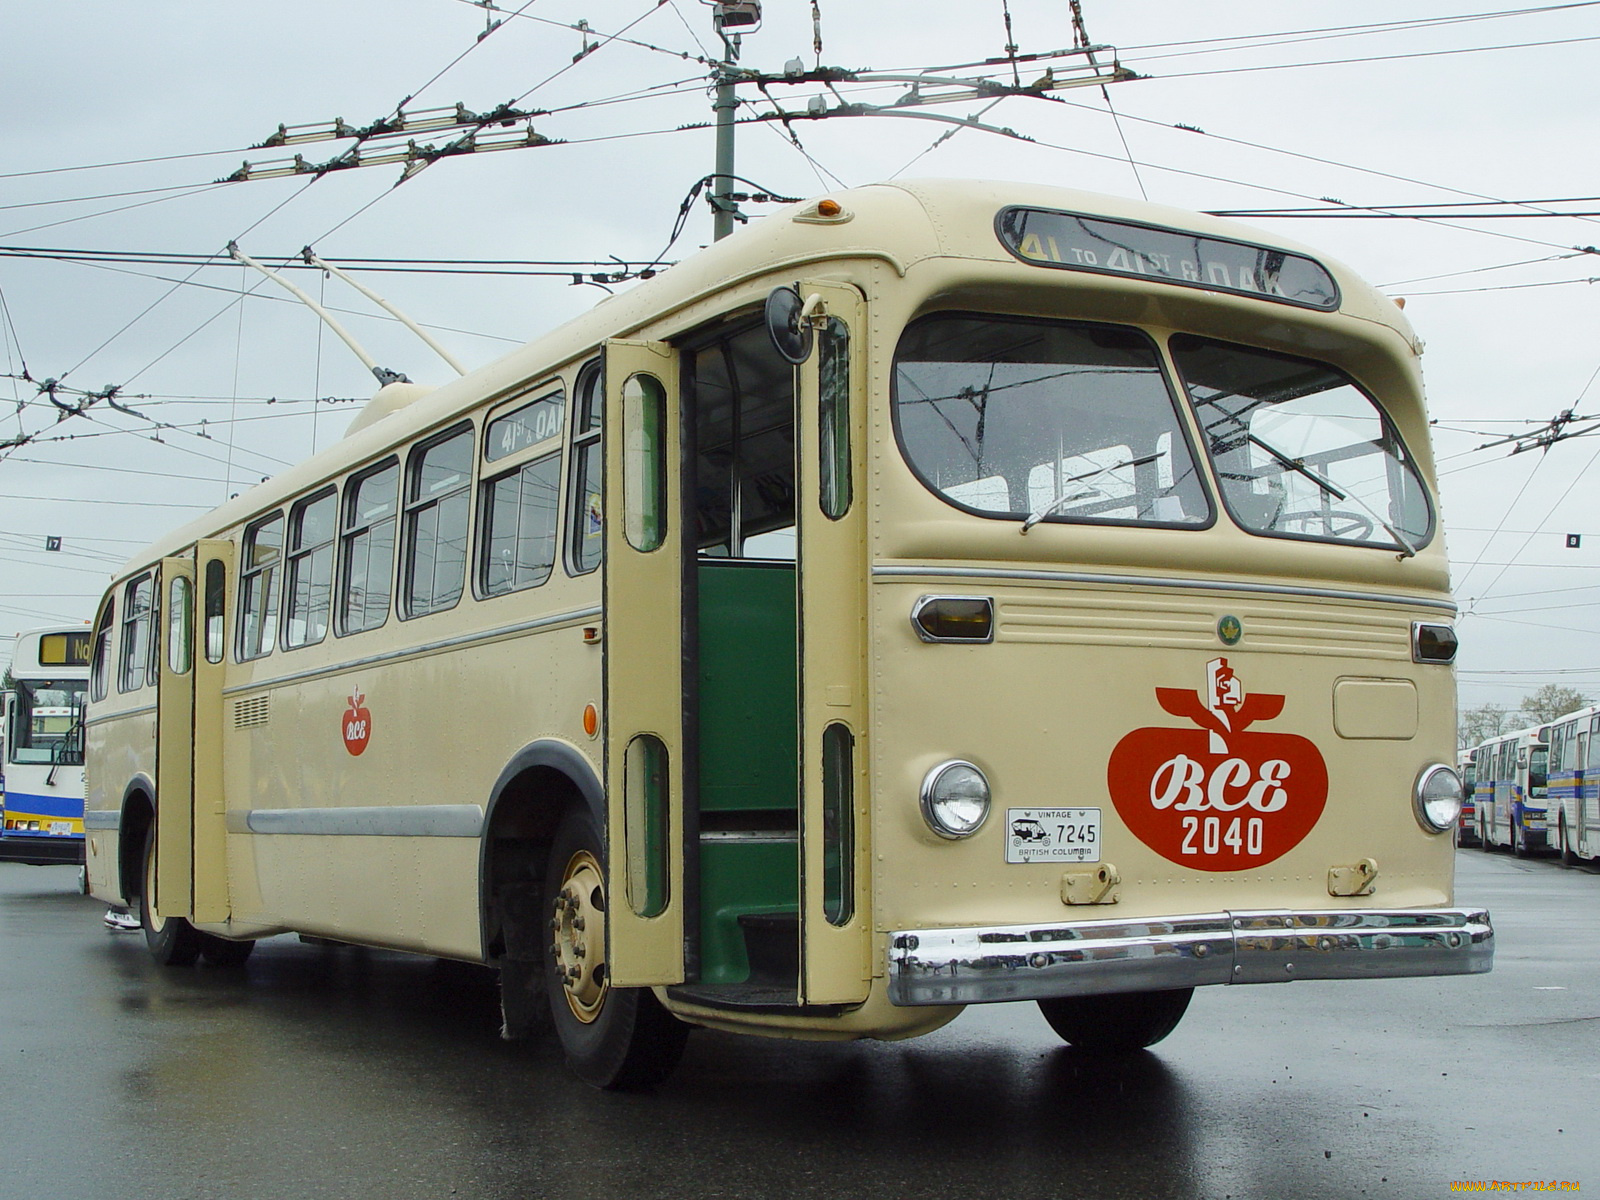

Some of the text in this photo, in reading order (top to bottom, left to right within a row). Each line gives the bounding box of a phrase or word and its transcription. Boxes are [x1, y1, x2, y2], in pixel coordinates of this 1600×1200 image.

[1020, 233, 1062, 262] 41
[1071, 248, 1097, 265] TO
[48, 539, 59, 549] 17
[347, 720, 366, 740] BCE
[1150, 754, 1291, 812] BCE
[1038, 811, 1072, 819] VINTAGE
[1057, 824, 1096, 843] 7245
[1181, 816, 1263, 855] 2040
[1018, 848, 1049, 856] BRITISH
